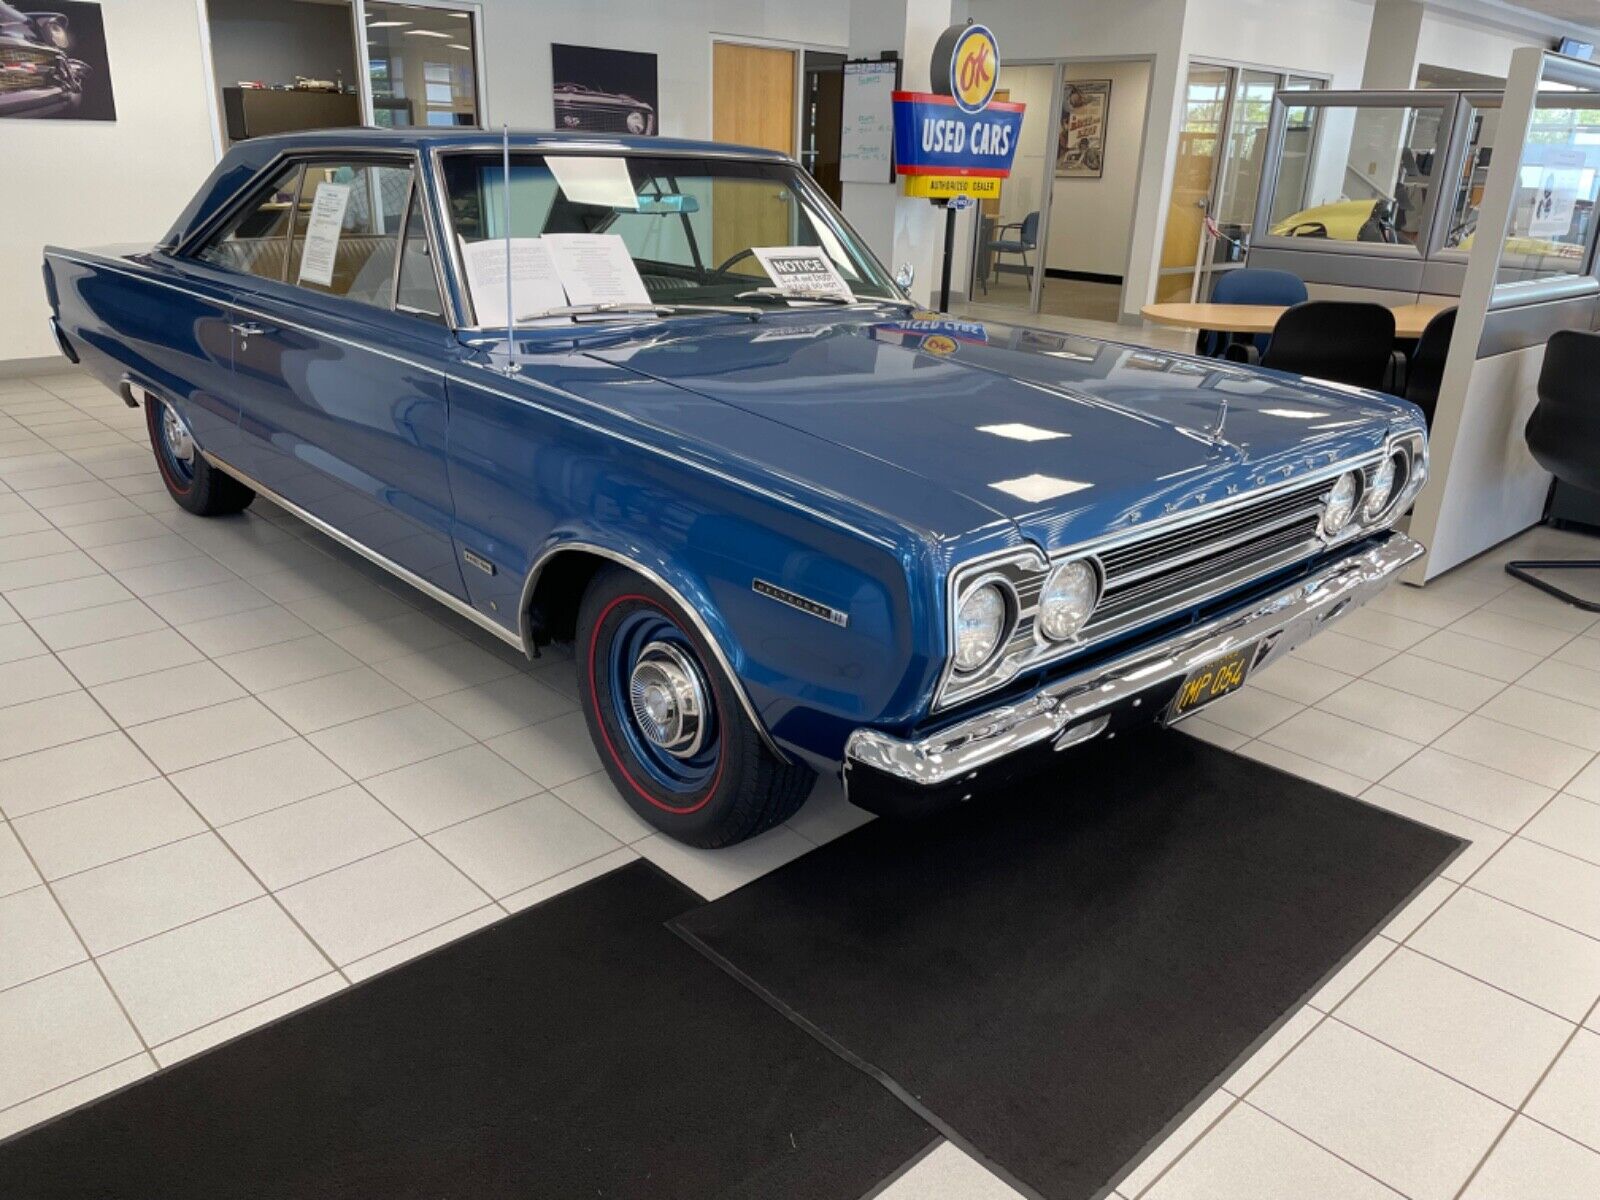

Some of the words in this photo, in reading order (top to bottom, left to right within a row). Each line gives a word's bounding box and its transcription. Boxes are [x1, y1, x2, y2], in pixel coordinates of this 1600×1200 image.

[960, 42, 990, 93] OK
[921, 118, 966, 154] USED
[970, 122, 1012, 157] CARS
[930, 179, 968, 192] AUTHORIZED
[972, 181, 995, 192] DEALER
[771, 259, 826, 273] NOTICE
[1210, 658, 1245, 695] 054
